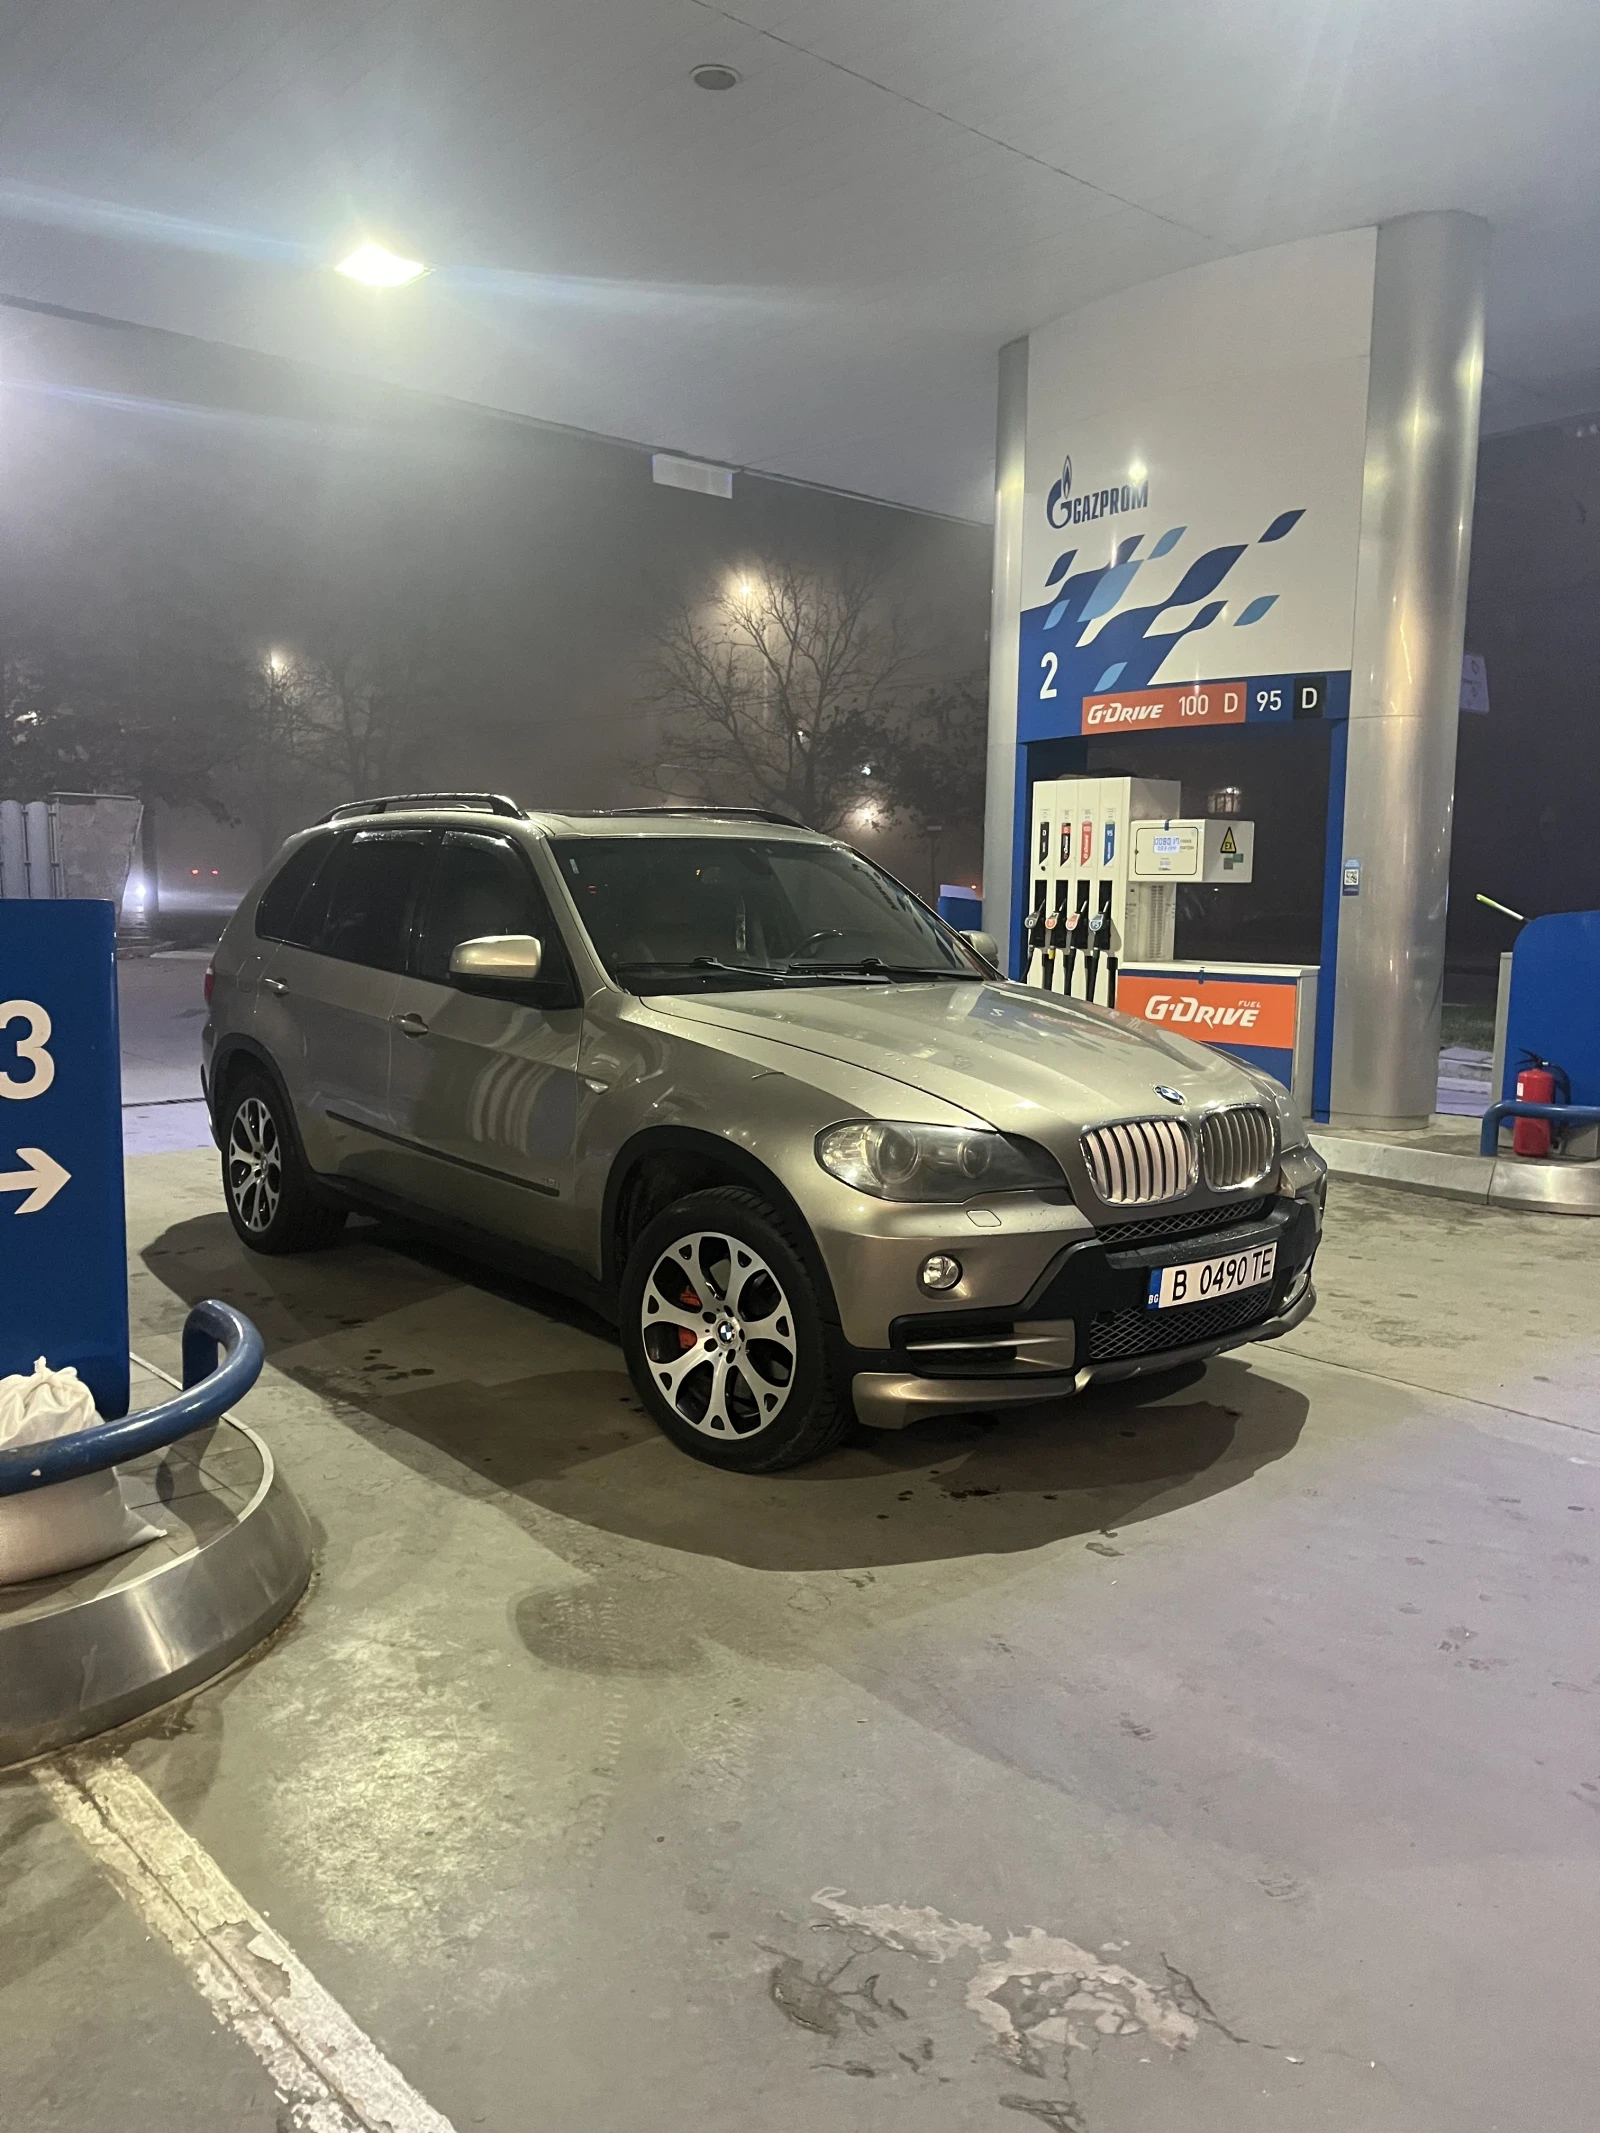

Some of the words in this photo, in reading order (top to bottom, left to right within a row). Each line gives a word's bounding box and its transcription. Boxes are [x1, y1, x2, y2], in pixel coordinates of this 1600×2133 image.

[1073, 480, 1148, 524] GAZPROM
[1040, 652, 1058, 699] 2
[1178, 694, 1209, 716] 100
[1223, 692, 1239, 713] D
[1256, 690, 1282, 712] 95
[1301, 687, 1318, 709] D
[1238, 1000, 1262, 1008] FUEL
[0, 1000, 55, 1100] 3
[1172, 1269, 1188, 1302] B
[1200, 1256, 1248, 1295] 0490
[1252, 1247, 1273, 1282] TE
[1148, 1294, 1159, 1304] BG
